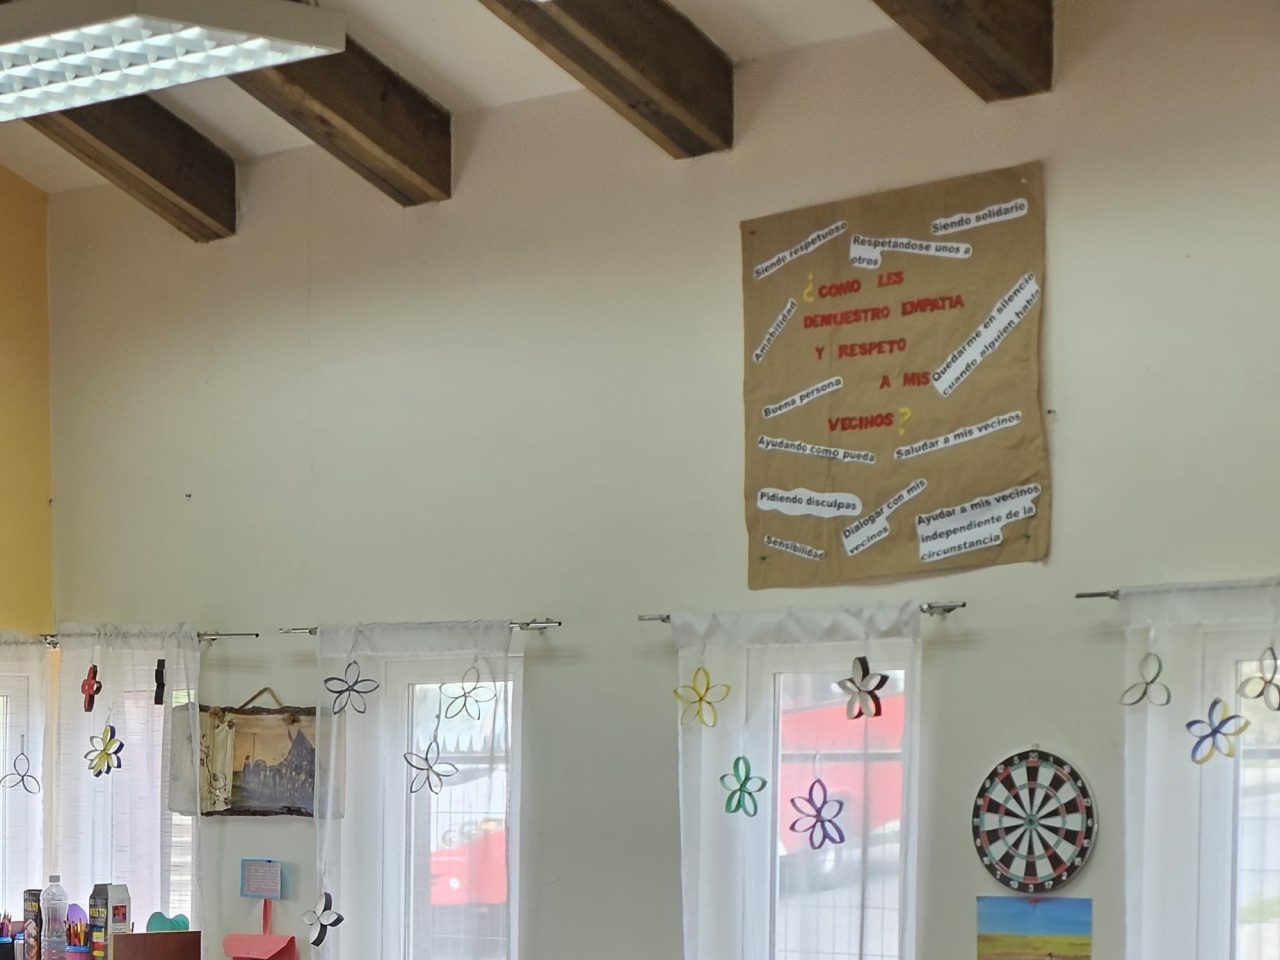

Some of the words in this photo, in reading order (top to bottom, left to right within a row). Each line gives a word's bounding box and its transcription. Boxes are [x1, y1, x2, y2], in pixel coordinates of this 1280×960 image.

[932, 217, 971, 233] Siendo
[975, 202, 1026, 222] solidario
[755, 255, 787, 278] Siendo
[789, 222, 847, 257] respetuoso
[851, 256, 879, 266] otros
[935, 244, 960, 255] unos
[878, 271, 904, 288] LES
[804, 306, 890, 329] DEMUESTRO
[901, 295, 965, 317] EMPATIA
[932, 330, 982, 382] Quedarme
[983, 314, 996, 330] en
[997, 273, 1035, 315] silencio
[754, 300, 797, 362] Amabilidad
[815, 346, 825, 360] Y
[838, 339, 906, 359] RESPETO
[943, 357, 978, 396] cuando
[980, 319, 1016, 358] alguien
[880, 374, 891, 390] A
[903, 371, 930, 387] MIS
[764, 398, 797, 417] Buena
[800, 379, 842, 403] persona
[759, 436, 808, 452] Ayudando
[810, 445, 839, 457] como
[842, 451, 875, 463] pueda
[896, 439, 939, 459] Saludar
[954, 428, 974, 441] mis
[977, 412, 1021, 433] vecinos
[759, 491, 804, 505] Pidiendo
[806, 497, 858, 511] disculpas
[843, 508, 885, 539] Dialogar
[887, 494, 905, 510] con
[907, 480, 926, 496] mis
[917, 508, 957, 525] Ayudar
[970, 498, 992, 511] mis
[994, 485, 1041, 503] vecinos
[921, 515, 1003, 543] independiente
[1005, 509, 1020, 521] de
[1023, 504, 1034, 515] la
[849, 526, 890, 554] vecinos
[921, 533, 1001, 561] circunstancia
[1028, 752, 1039, 760] 20
